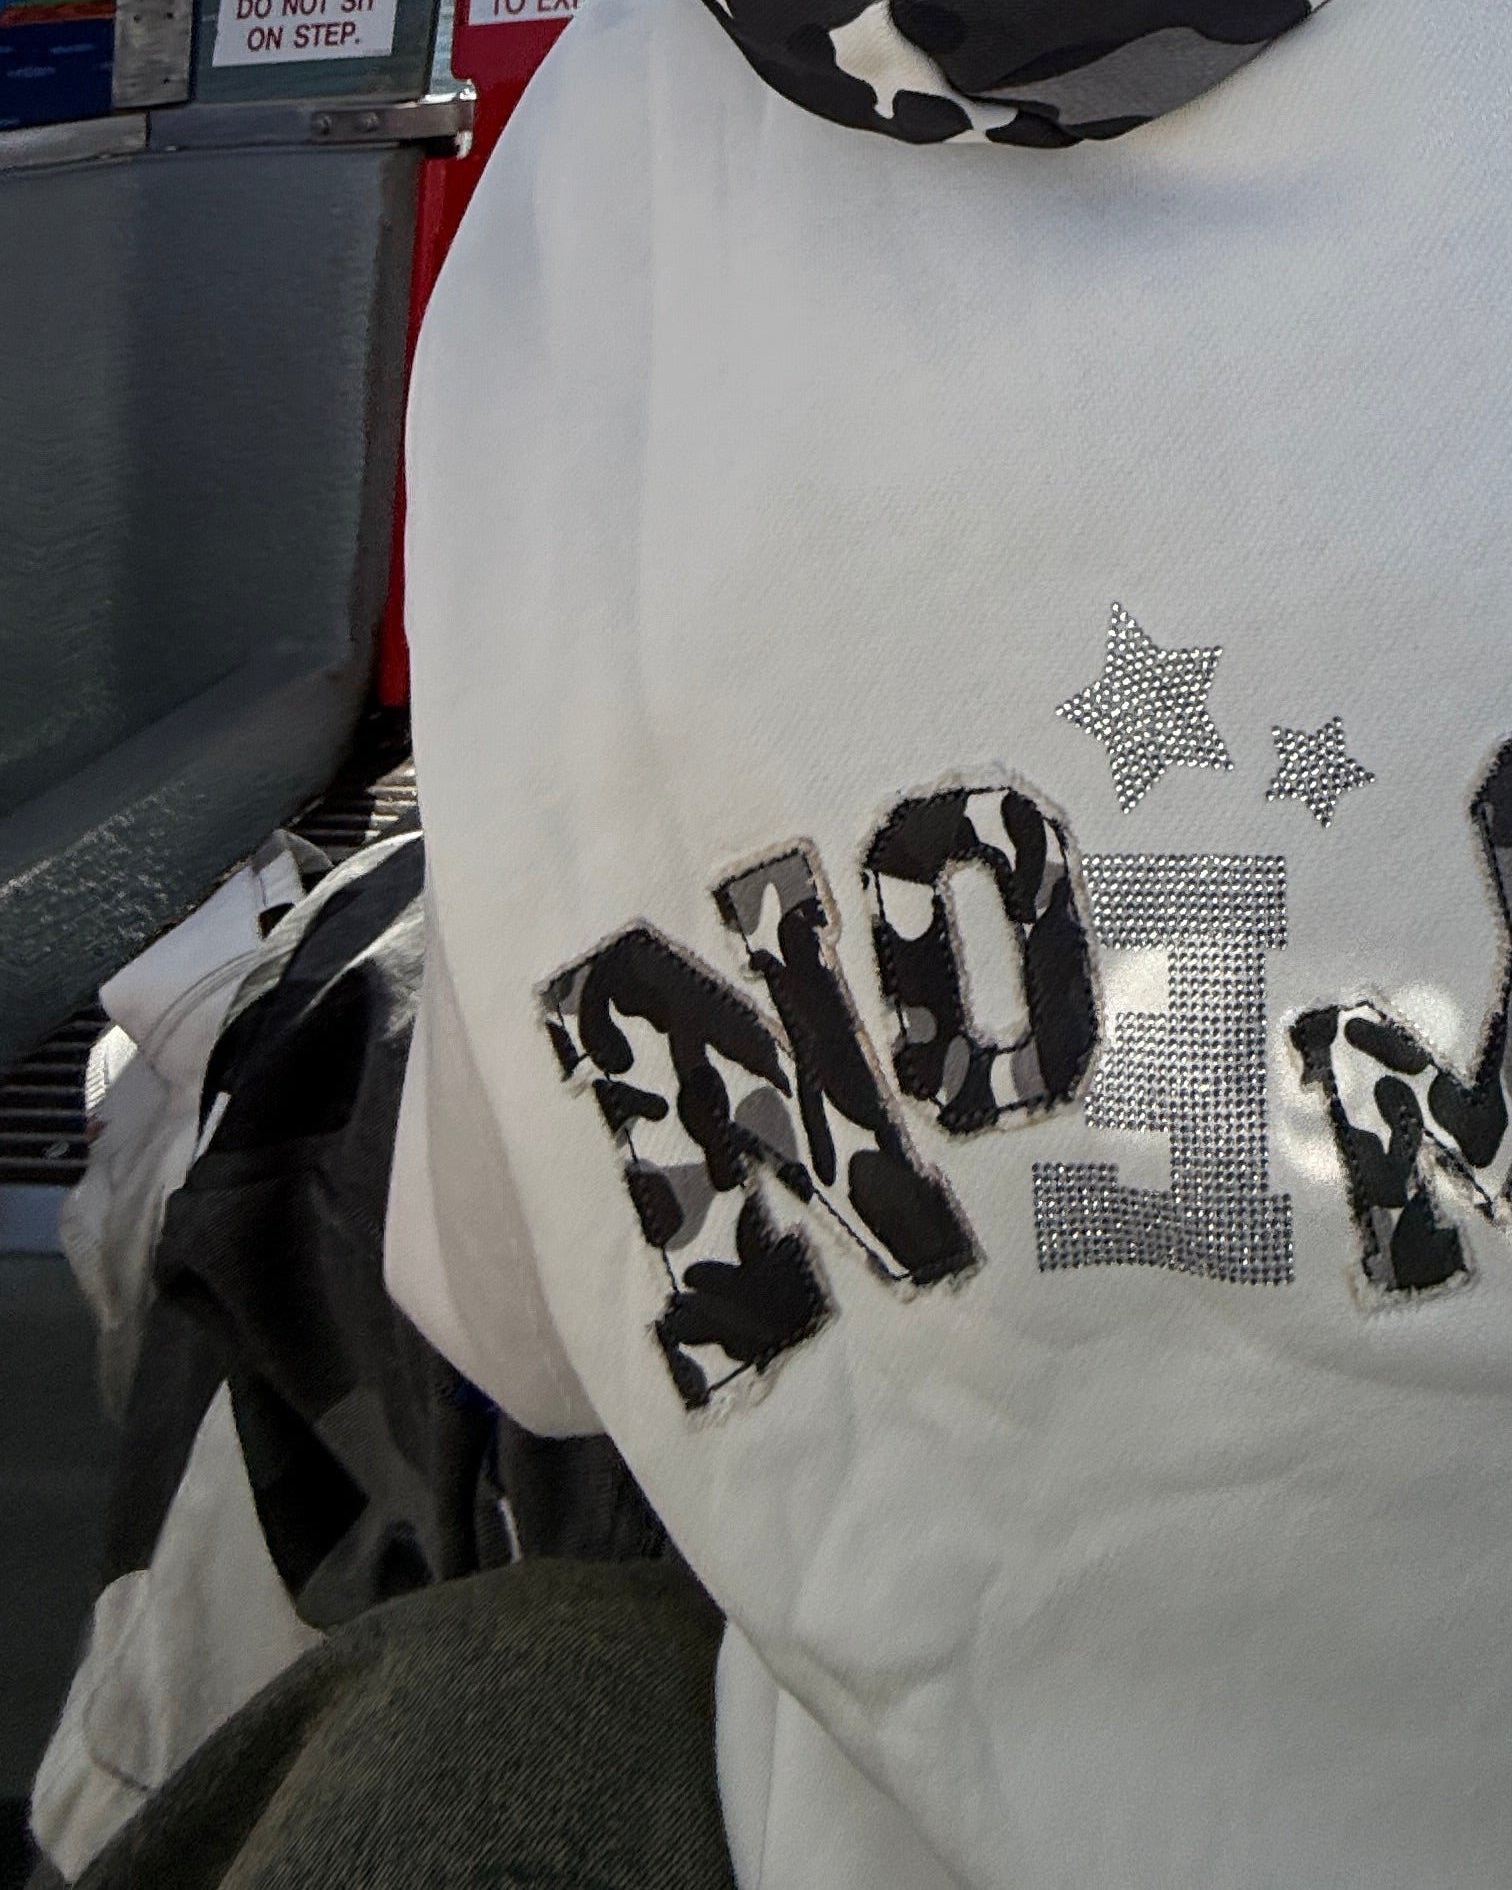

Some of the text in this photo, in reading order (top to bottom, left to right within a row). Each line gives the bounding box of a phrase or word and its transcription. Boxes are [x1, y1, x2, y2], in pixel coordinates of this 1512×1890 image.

[247, 21, 361, 52] ON STEP.
[536, 772, 1104, 1415] NO
